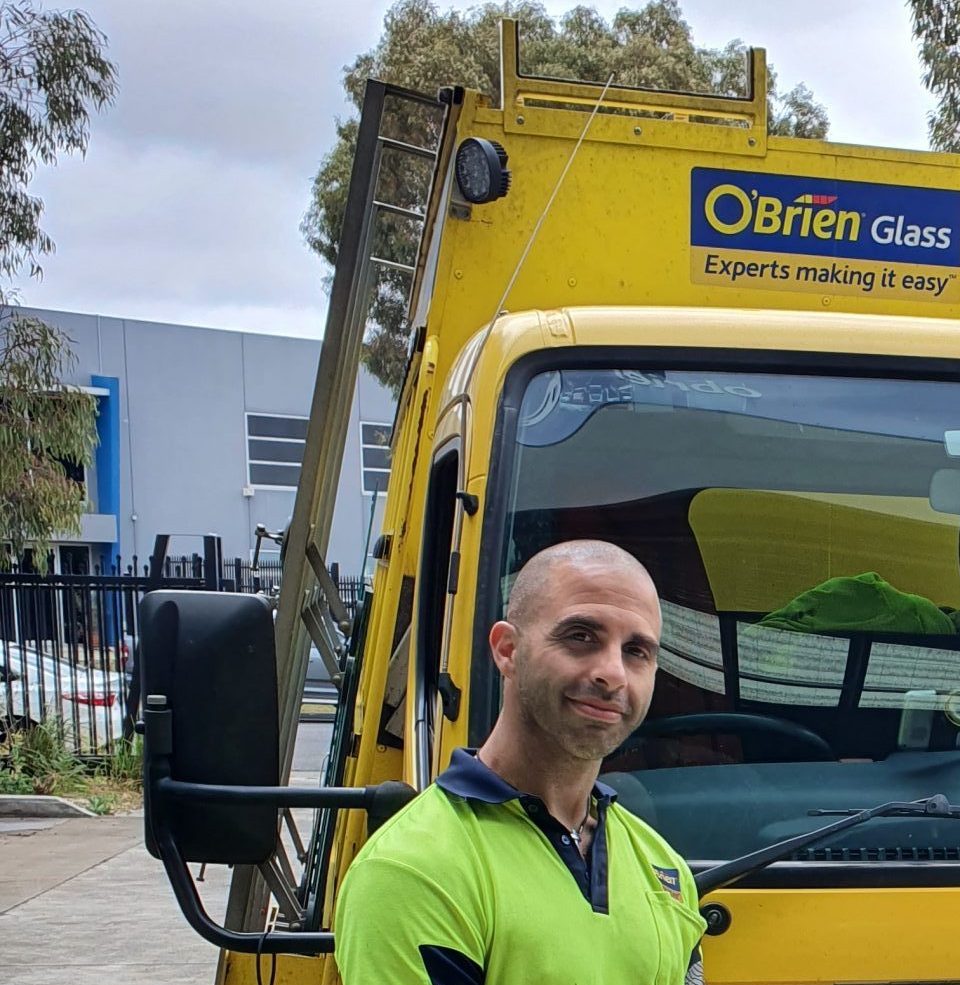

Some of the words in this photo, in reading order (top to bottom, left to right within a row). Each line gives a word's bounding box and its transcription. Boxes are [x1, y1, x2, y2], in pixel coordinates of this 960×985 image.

[705, 183, 861, 242] O'Brien
[870, 215, 952, 250] Glass
[704, 254, 790, 281] Experts
[796, 263, 876, 292] making
[881, 267, 896, 289] it
